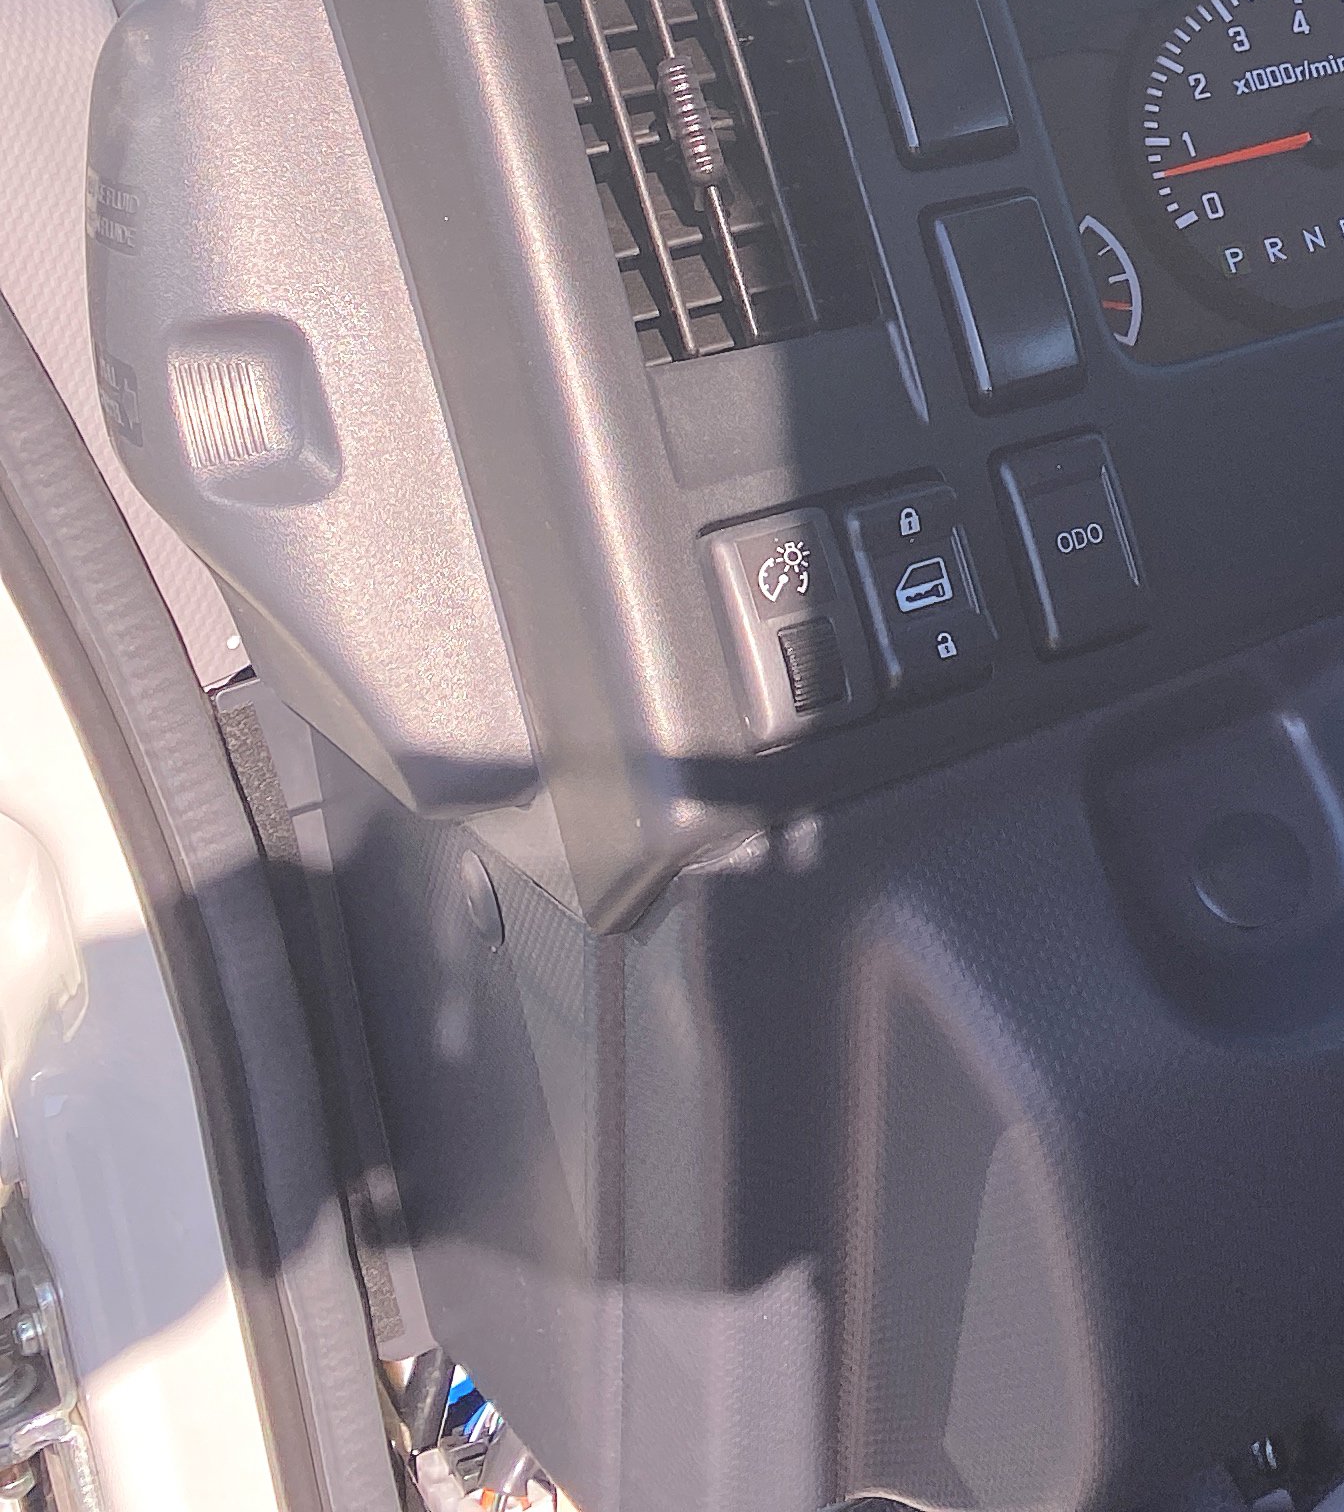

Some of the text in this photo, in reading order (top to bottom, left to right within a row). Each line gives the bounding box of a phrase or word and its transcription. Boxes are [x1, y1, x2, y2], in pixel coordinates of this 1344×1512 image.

[1292, 9, 1310, 35] 4
[1227, 26, 1250, 52] 3
[1188, 73, 1211, 100] 2
[1181, 132, 1197, 157] 1
[1202, 192, 1225, 219] 0
[1224, 247, 1244, 273] P
[1263, 237, 1287, 262] R
[1303, 226, 1326, 252] N
[1057, 523, 1103, 554] ODO
